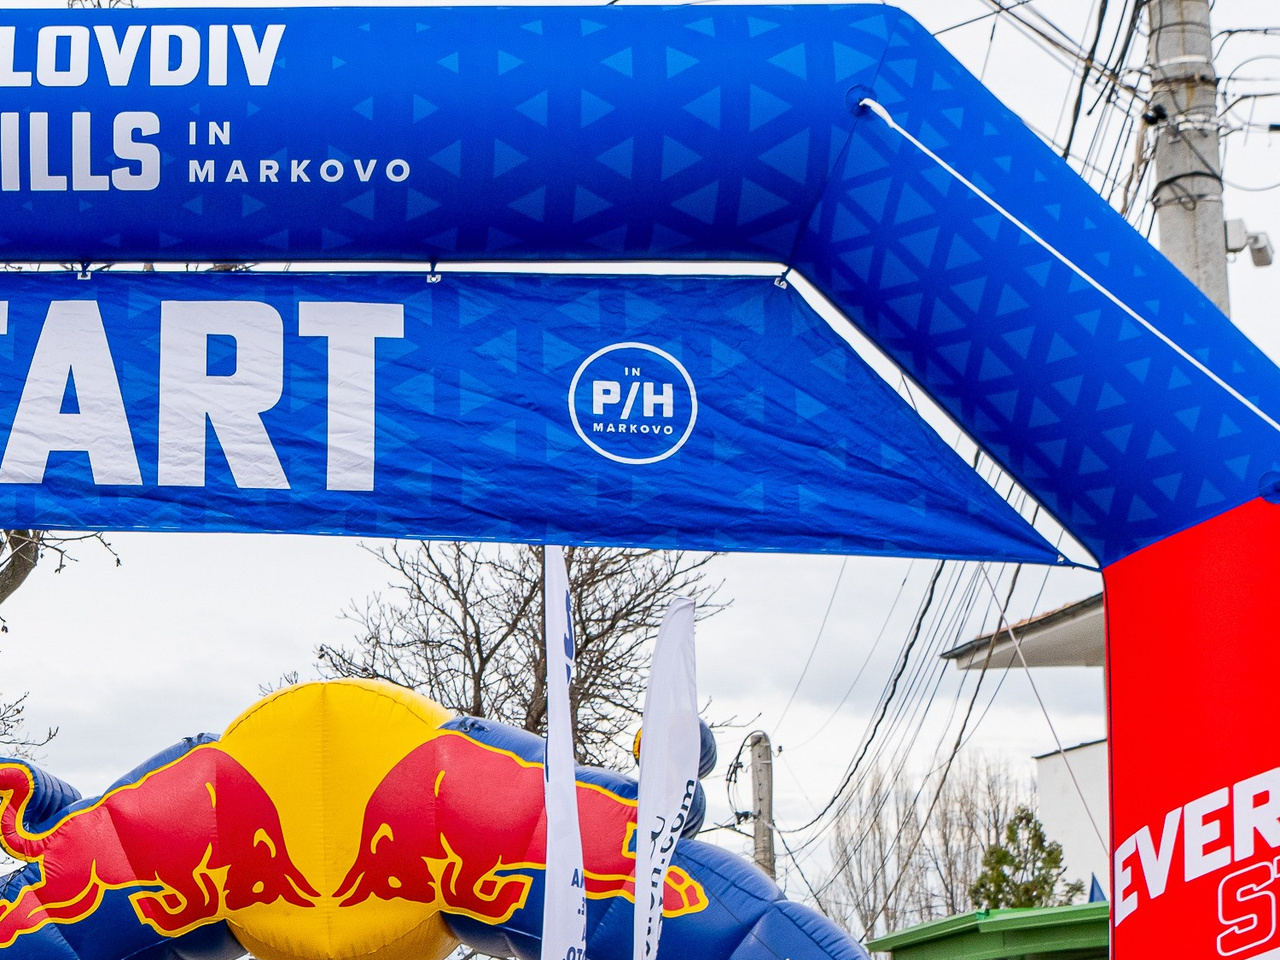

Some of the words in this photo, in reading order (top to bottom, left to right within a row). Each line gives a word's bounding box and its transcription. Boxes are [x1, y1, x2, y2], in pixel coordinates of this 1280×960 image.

[188, 121, 231, 146] IN
[188, 158, 412, 183] MARKOVO
[623, 366, 642, 377] IN
[591, 380, 674, 420] P/H
[592, 422, 675, 436] MARKOVO
